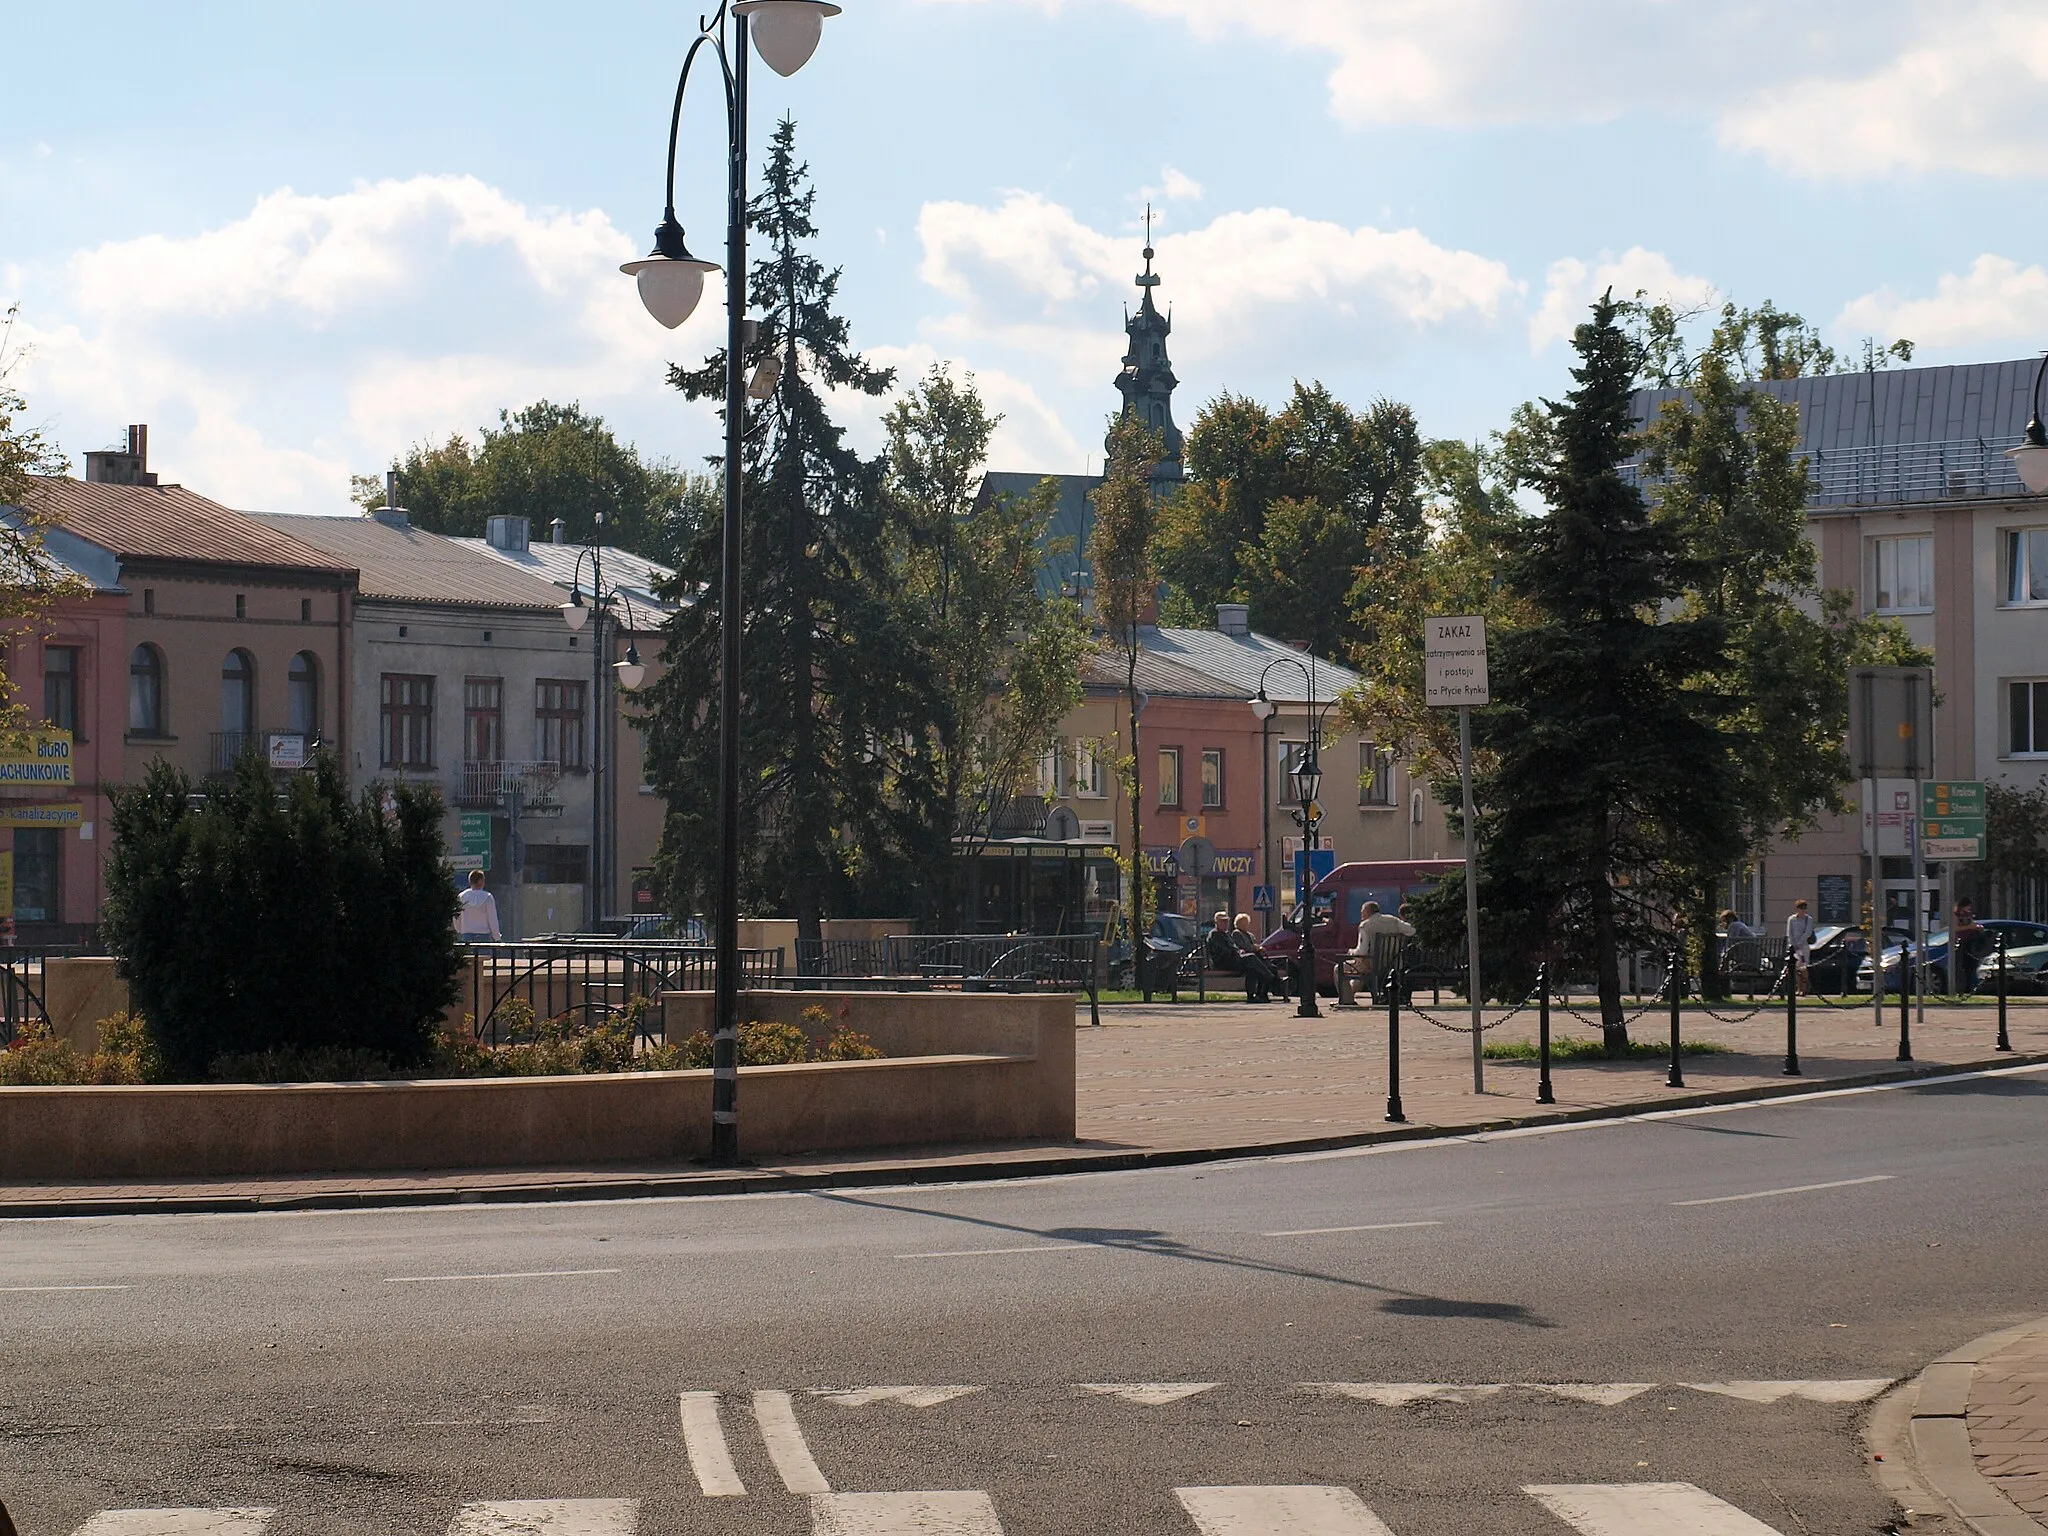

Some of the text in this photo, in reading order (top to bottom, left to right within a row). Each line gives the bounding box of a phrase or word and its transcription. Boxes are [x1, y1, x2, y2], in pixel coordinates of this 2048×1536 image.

[1438, 625, 1471, 638] ZAKAZ
[1426, 647, 1475, 659] zatrzymywania
[1445, 666, 1474, 678] postoju
[1464, 685, 1487, 696] Rynku
[37, 742, 69, 757] BIURO
[11, 805, 79, 824] kanalizacyjne
